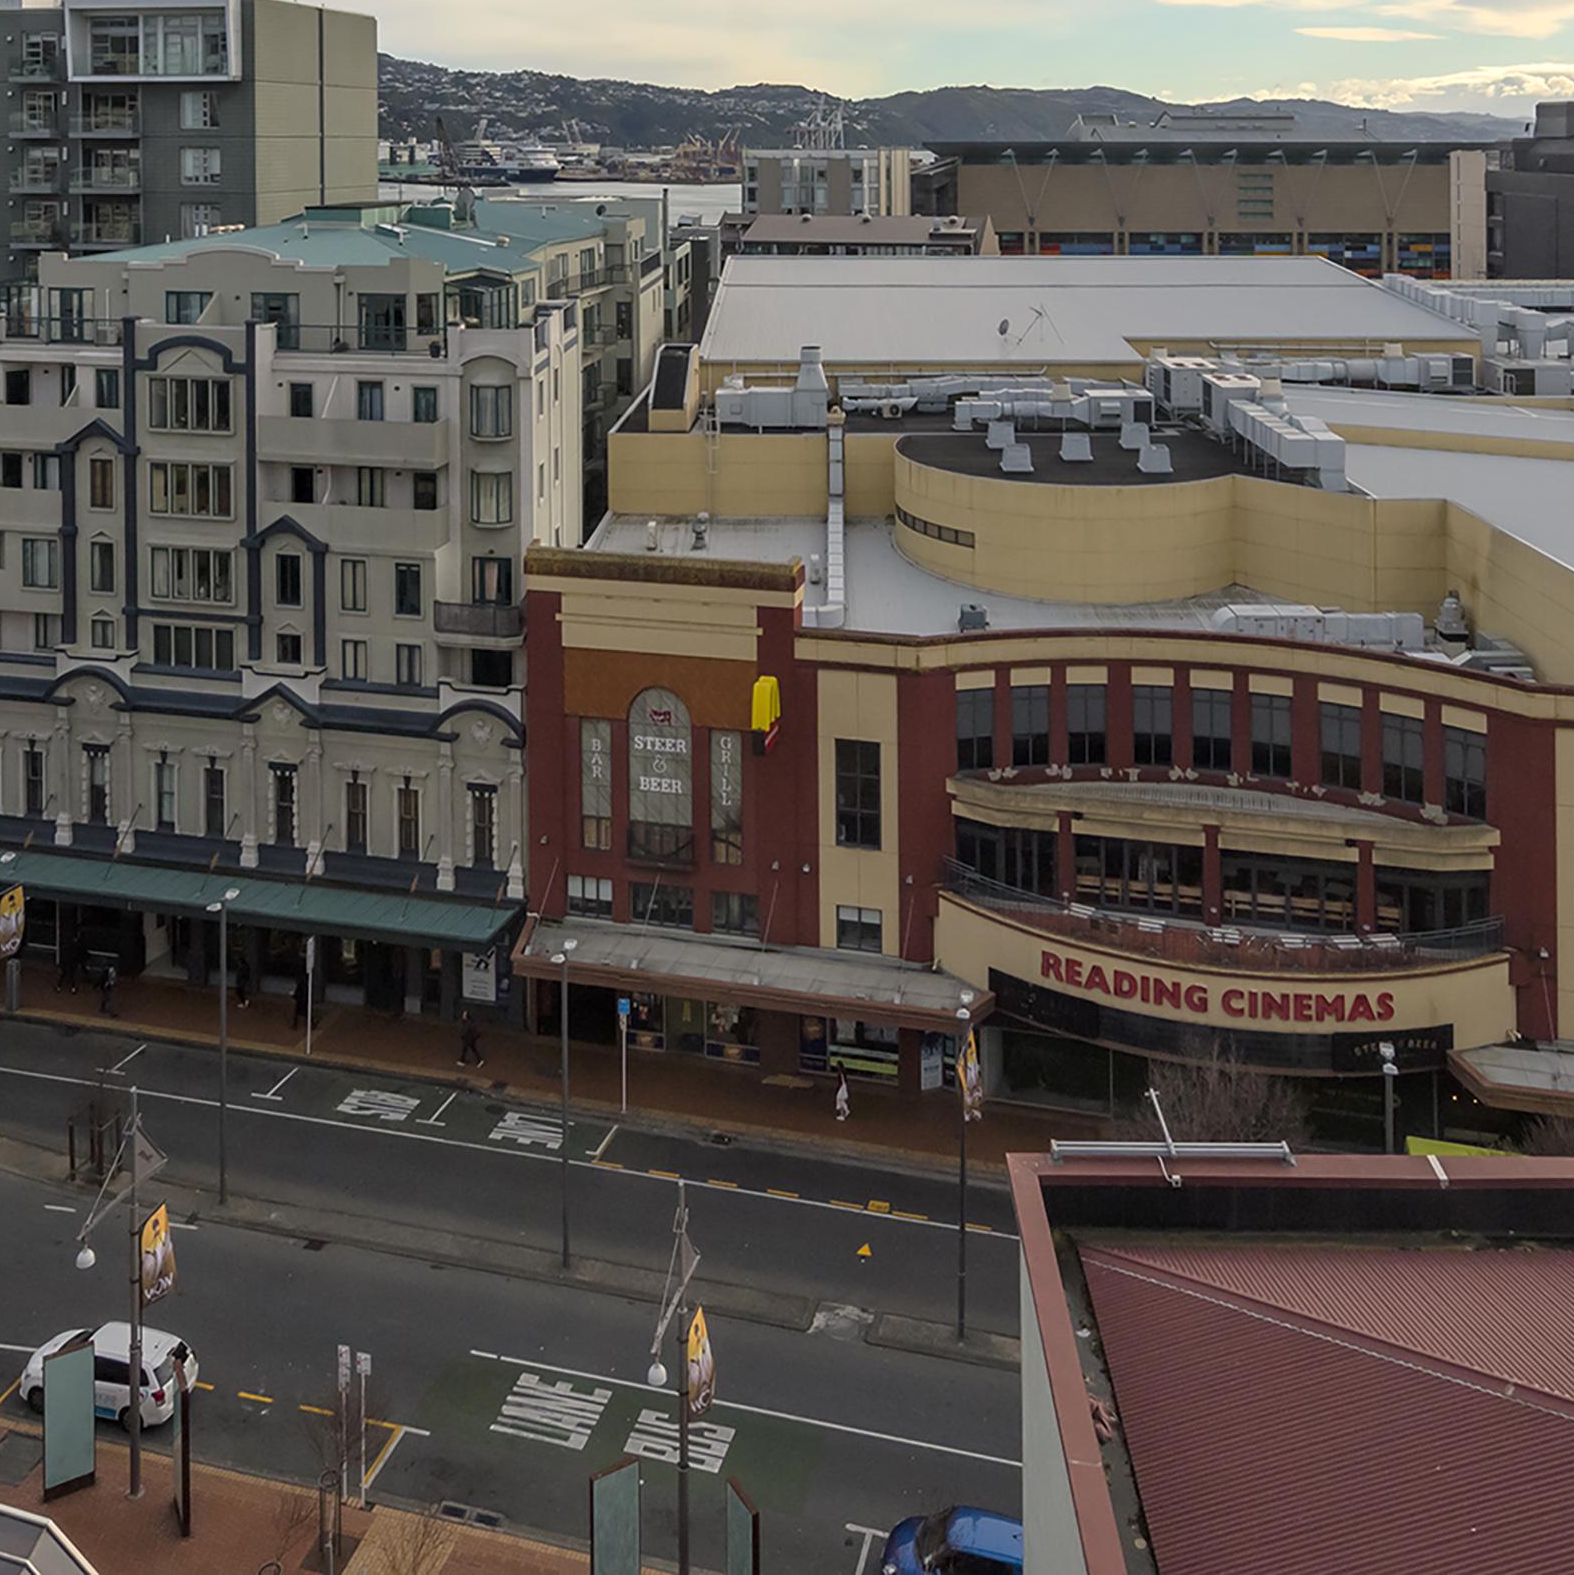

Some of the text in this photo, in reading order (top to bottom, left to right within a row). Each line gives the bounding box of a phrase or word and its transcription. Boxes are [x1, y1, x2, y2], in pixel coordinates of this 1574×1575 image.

[591, 738, 603, 779] BAR
[634, 735, 687, 754] STEER
[652, 754, 667, 774] &
[639, 776, 683, 794] BEER
[720, 736, 732, 806] GRILL
[1040, 950, 1395, 1023] READING CINEMAS
[489, 1372, 736, 1474] BUS LANE
